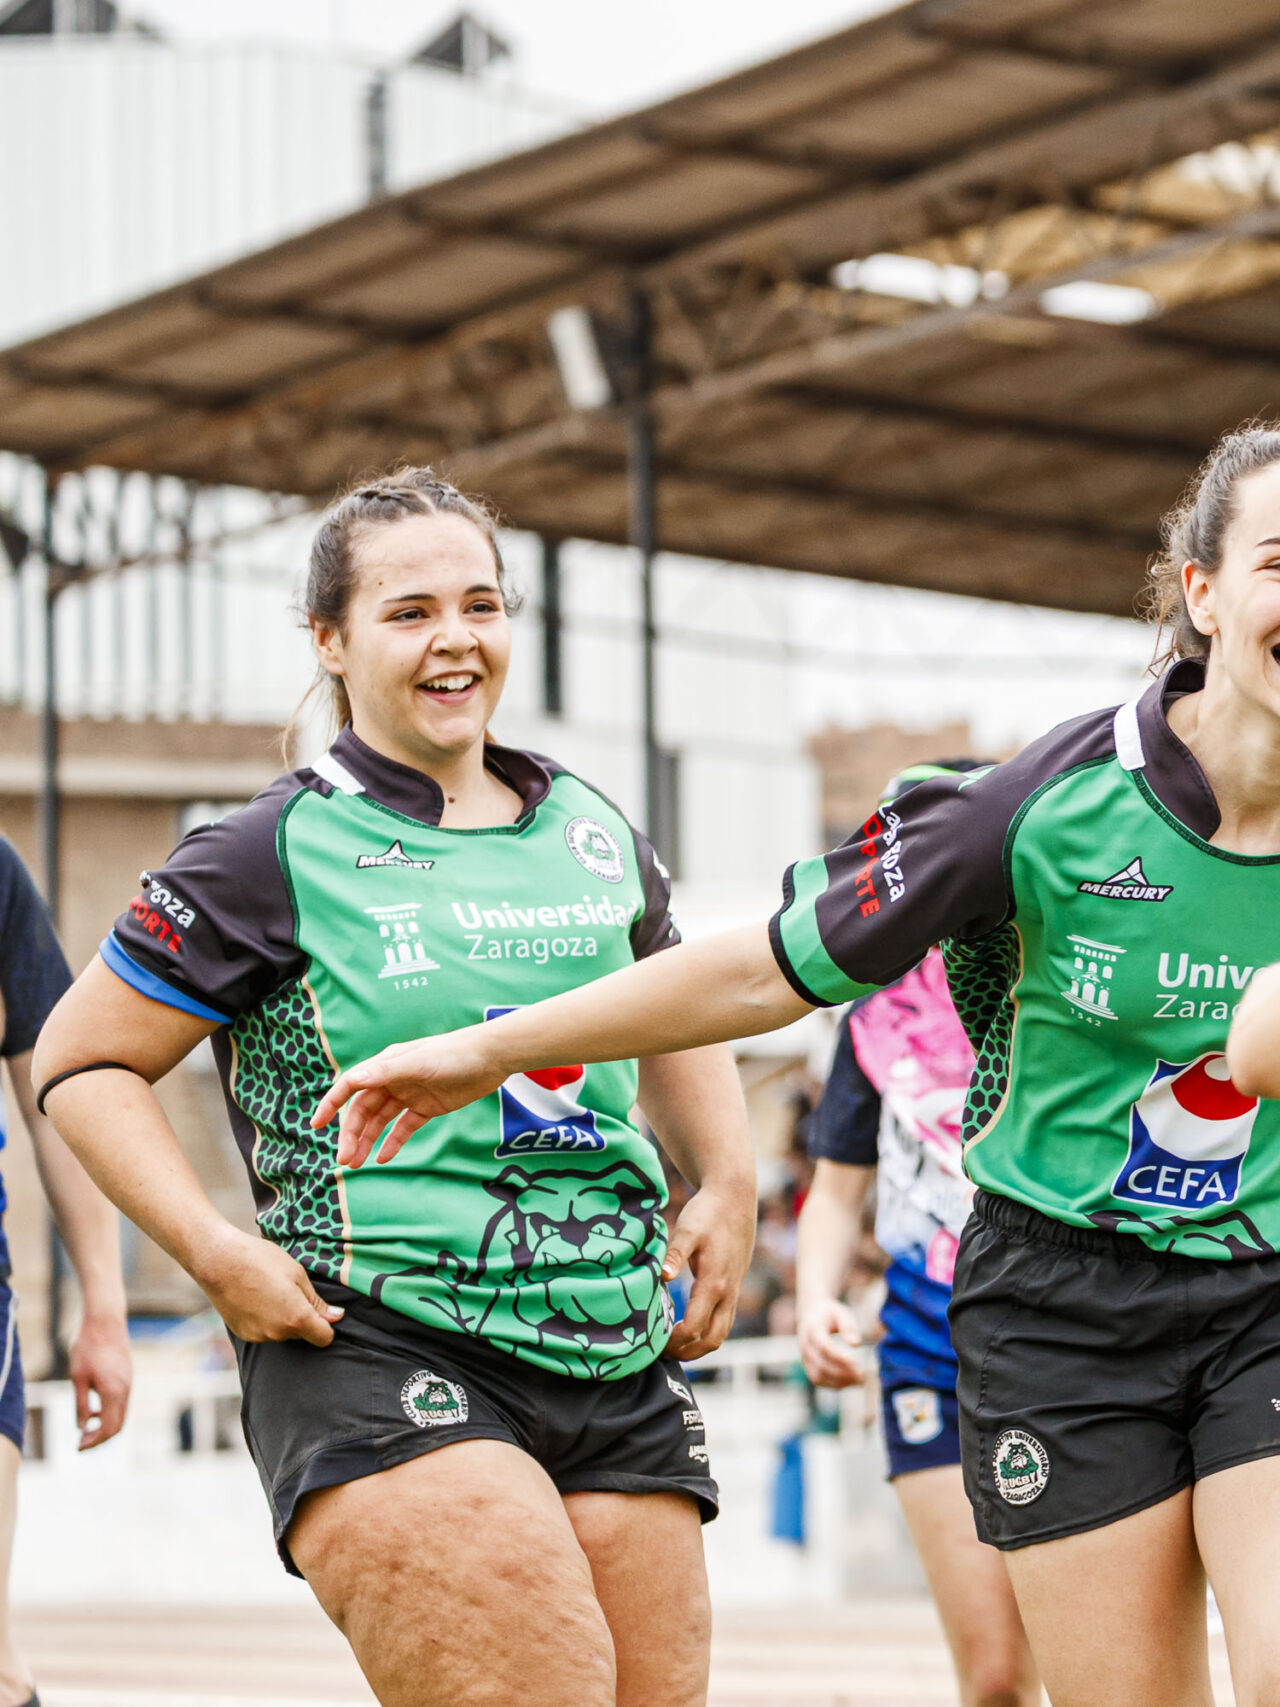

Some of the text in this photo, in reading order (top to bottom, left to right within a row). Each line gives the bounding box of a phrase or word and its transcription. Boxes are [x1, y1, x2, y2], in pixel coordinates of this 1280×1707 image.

[1080, 882, 1171, 900] MERCURY
[463, 934, 598, 964] Zaragoza
[393, 976, 429, 990] 1542
[1070, 1007, 1102, 1027] 1542
[1153, 994, 1241, 1020] Zara
[508, 1125, 598, 1149] CEFA
[1127, 1165, 1227, 1202] CEFA
[420, 1409, 460, 1420] RUGBY
[1002, 1471, 1038, 1490] RUGBY
